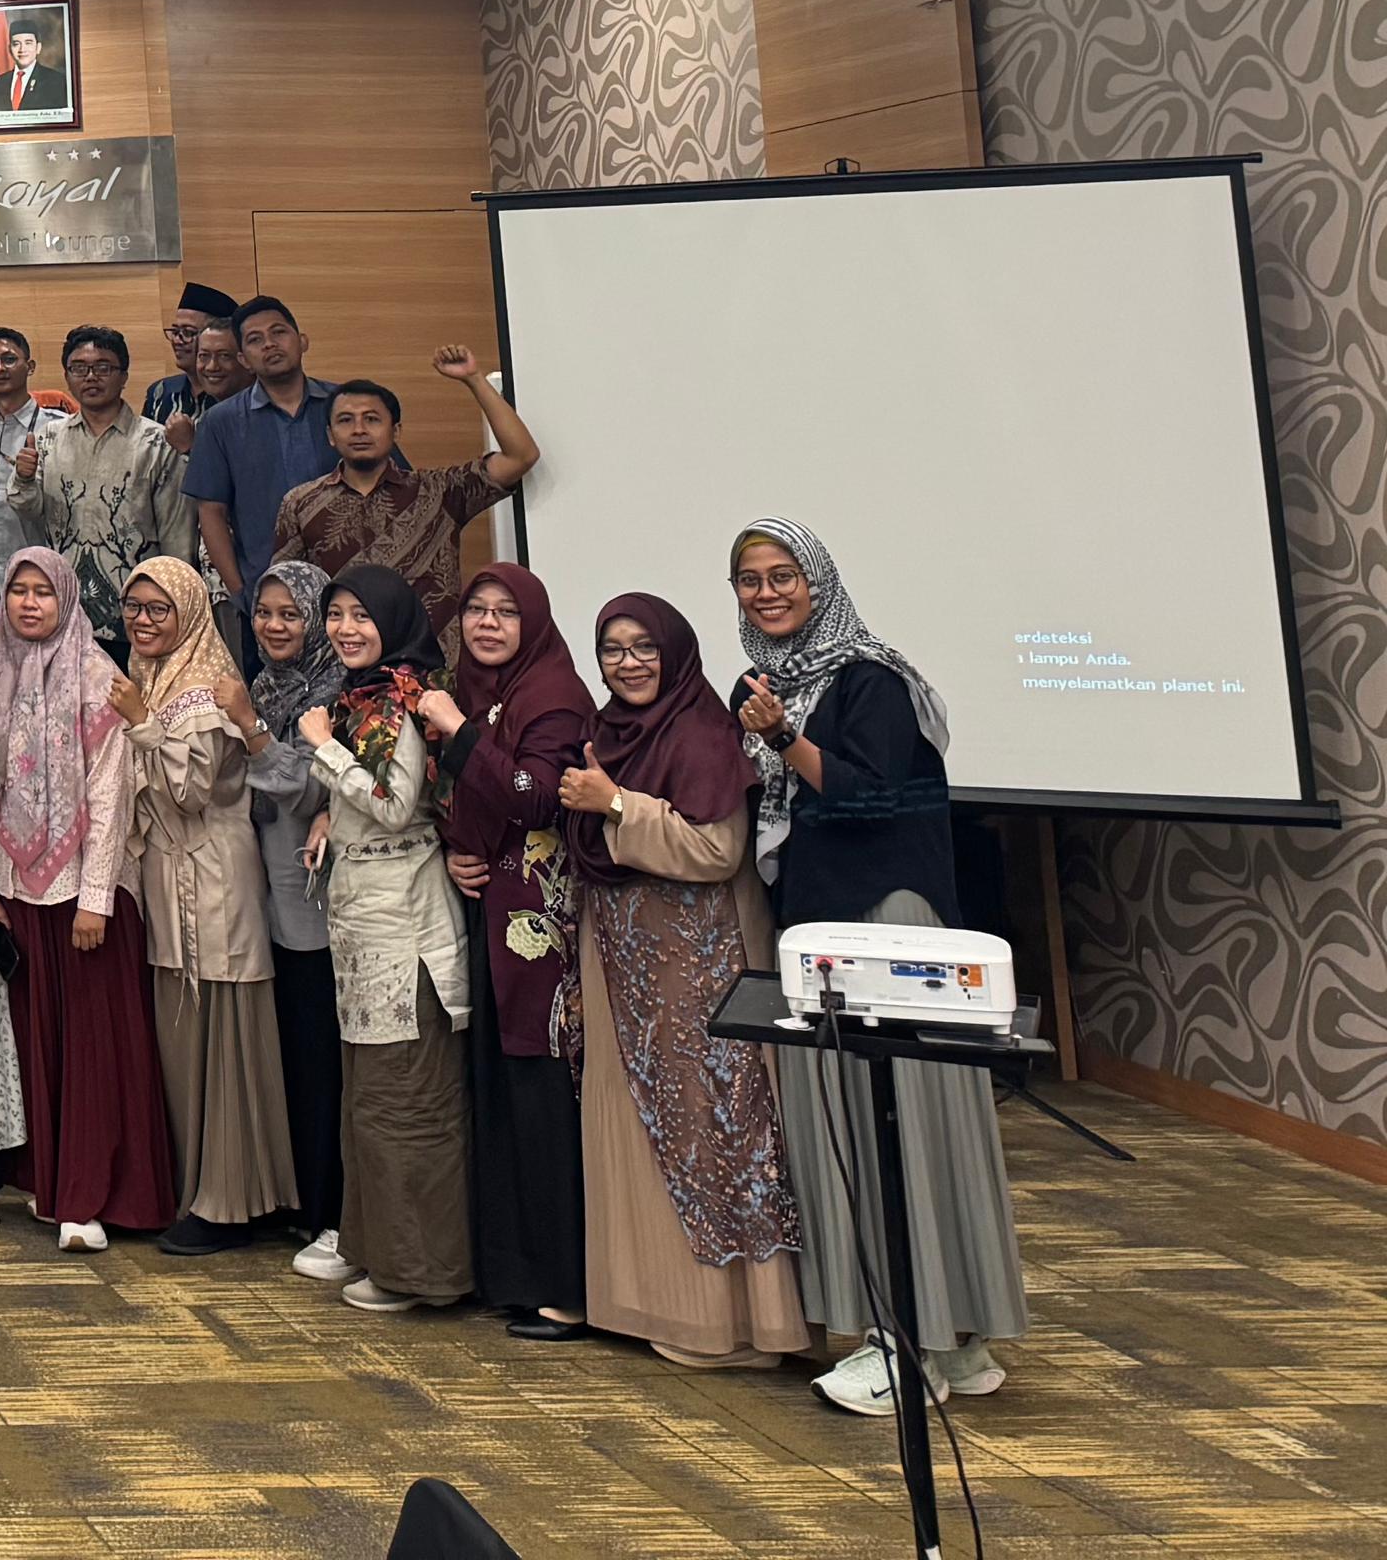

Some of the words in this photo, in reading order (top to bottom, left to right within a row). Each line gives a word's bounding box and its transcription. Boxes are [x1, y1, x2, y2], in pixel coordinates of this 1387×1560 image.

[45, 231, 131, 257] lounge
[1014, 631, 1093, 645] erdeteksi
[1029, 651, 1080, 666] lampu
[1085, 652, 1132, 666] Anda.
[1022, 676, 1156, 691] menyelamatkan
[1162, 678, 1216, 694] planet
[1221, 679, 1246, 693] ini.
